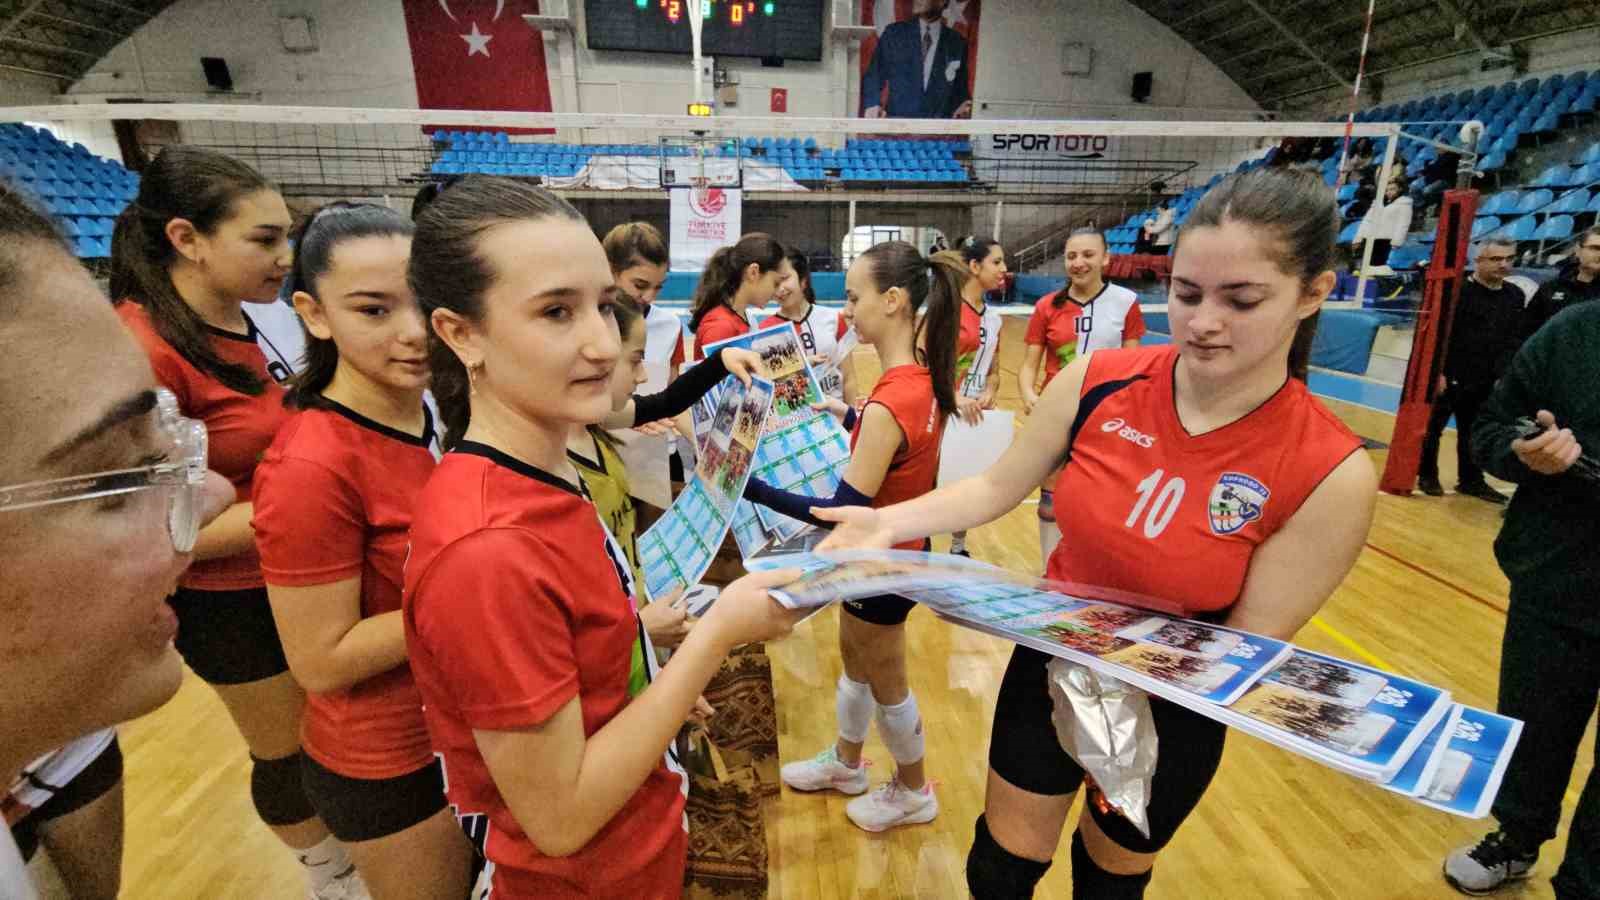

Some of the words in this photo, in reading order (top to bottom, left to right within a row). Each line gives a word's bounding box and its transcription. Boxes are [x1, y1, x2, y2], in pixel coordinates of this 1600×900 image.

[668, 0, 680, 19] 2
[731, 4, 743, 22] 0
[1074, 316, 1093, 334] 10
[800, 332, 814, 350] 8
[1119, 425, 1156, 448] asics
[1124, 468, 1186, 539] 10
